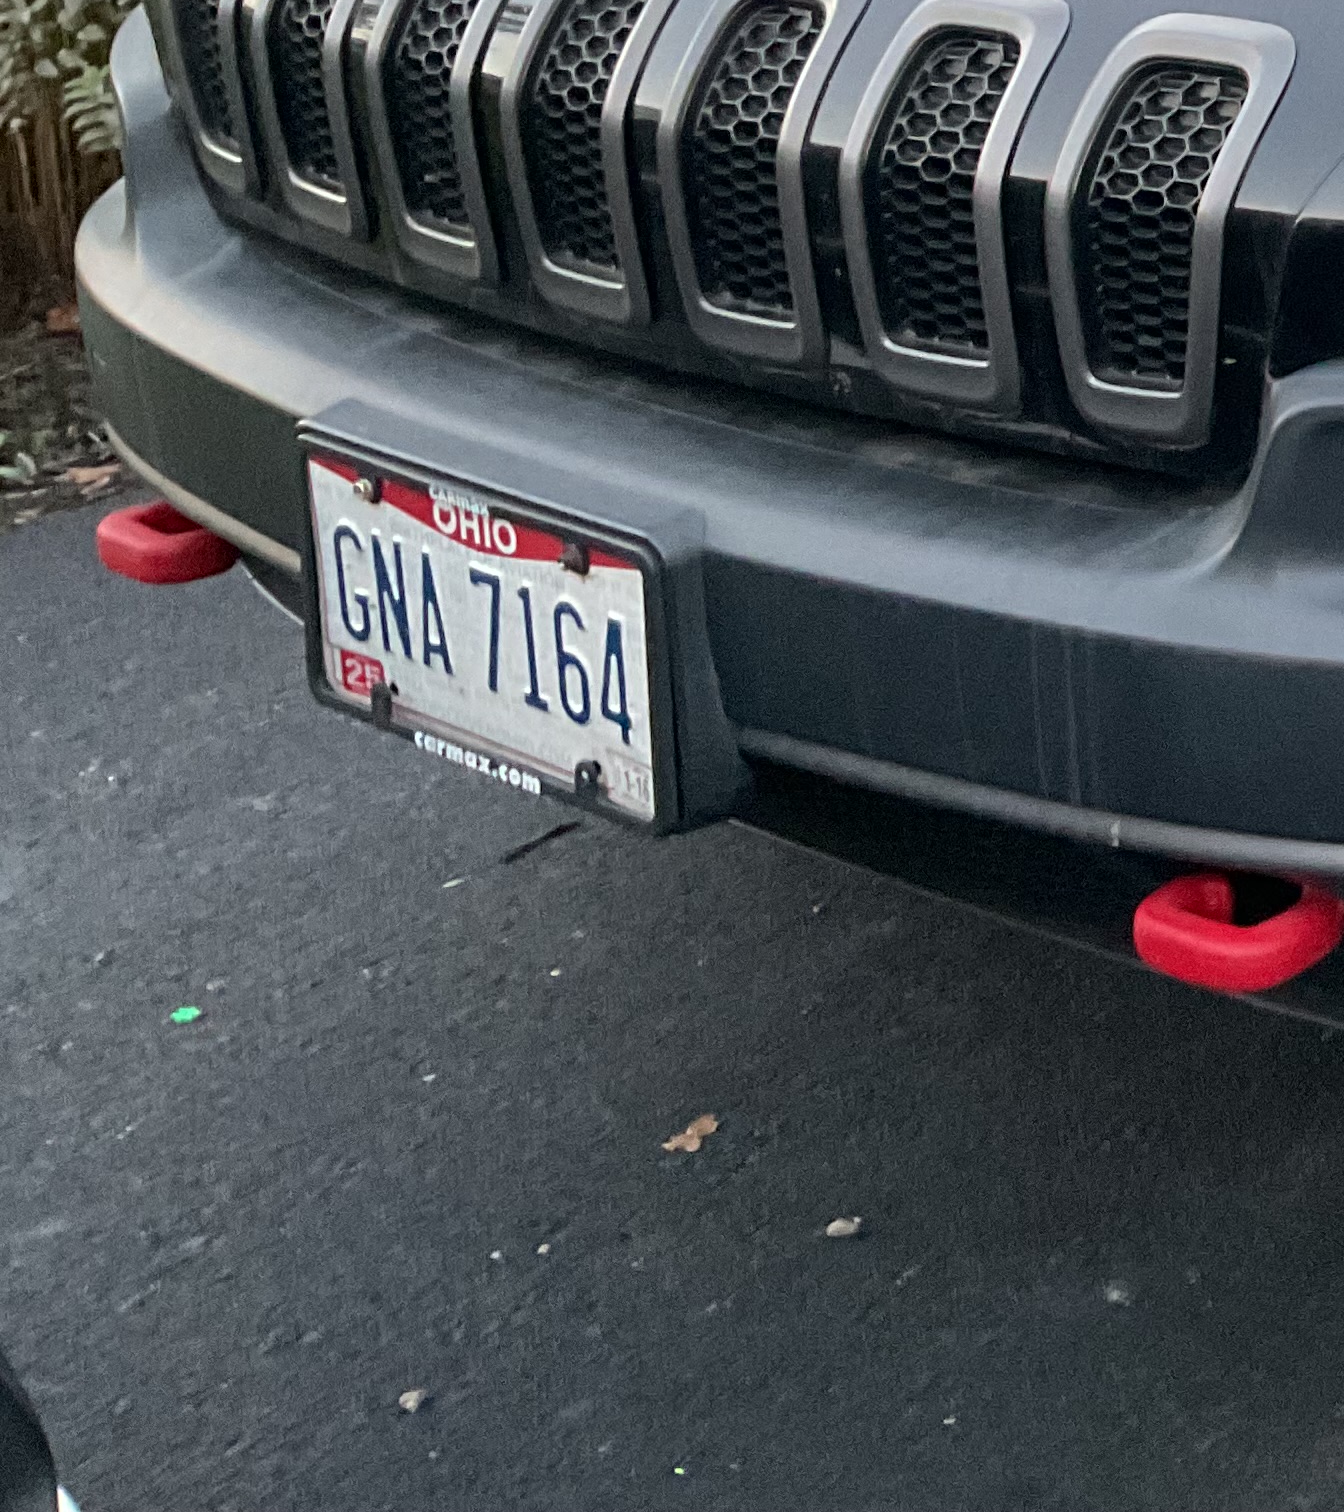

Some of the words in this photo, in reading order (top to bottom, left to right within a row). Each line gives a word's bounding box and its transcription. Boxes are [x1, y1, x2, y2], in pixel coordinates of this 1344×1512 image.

[432, 500, 518, 555] OHIO
[333, 522, 453, 676] GNA
[470, 566, 632, 745] 7164
[414, 730, 541, 795] carmax.com
